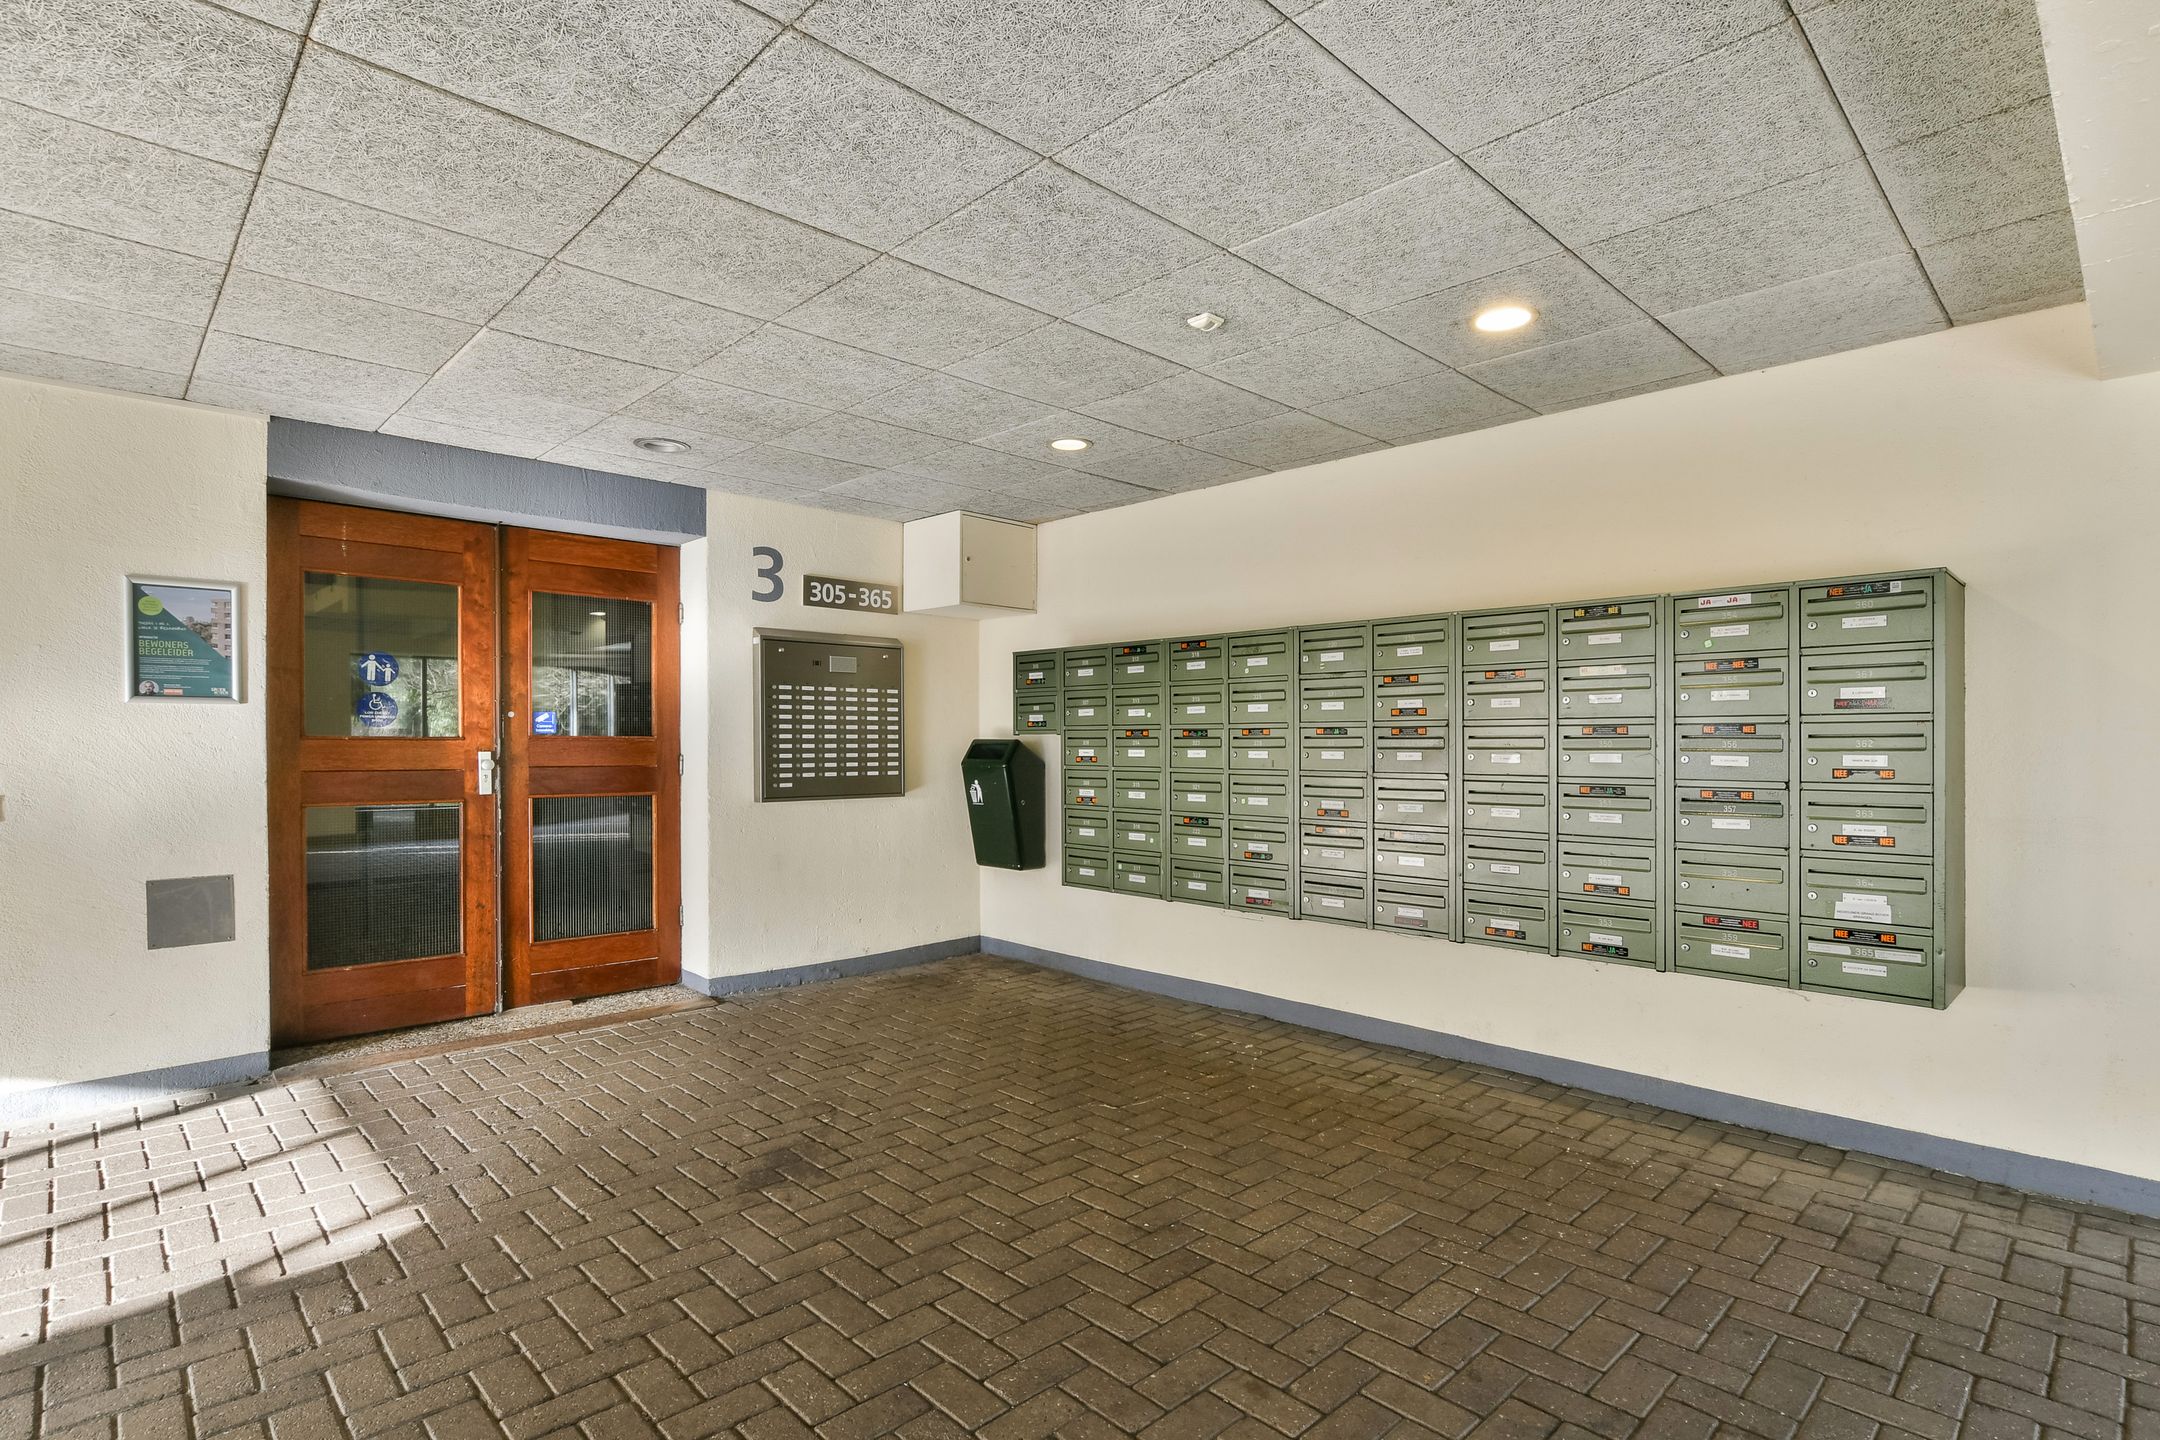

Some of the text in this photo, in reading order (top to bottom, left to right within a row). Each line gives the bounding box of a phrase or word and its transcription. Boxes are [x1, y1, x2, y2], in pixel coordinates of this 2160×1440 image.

[752, 546, 784, 602] 3
[1829, 584, 1873, 596] NEE JA
[139, 640, 189, 648] BEWONERS
[139, 648, 194, 656] BEGELEIDER
[1703, 725, 1755, 734] NEE NEE
[1834, 769, 1894, 779] NEE NEE
[1701, 790, 1753, 800] NEE NEE
[1834, 836, 1895, 847] NEE NEE
[1618, 887, 1629, 896] NEE
[1704, 915, 1758, 929] NEE NEE
[1835, 929, 1849, 938] NEE
[1880, 934, 1895, 943] NEE
[1608, 946, 1616, 954] JA
